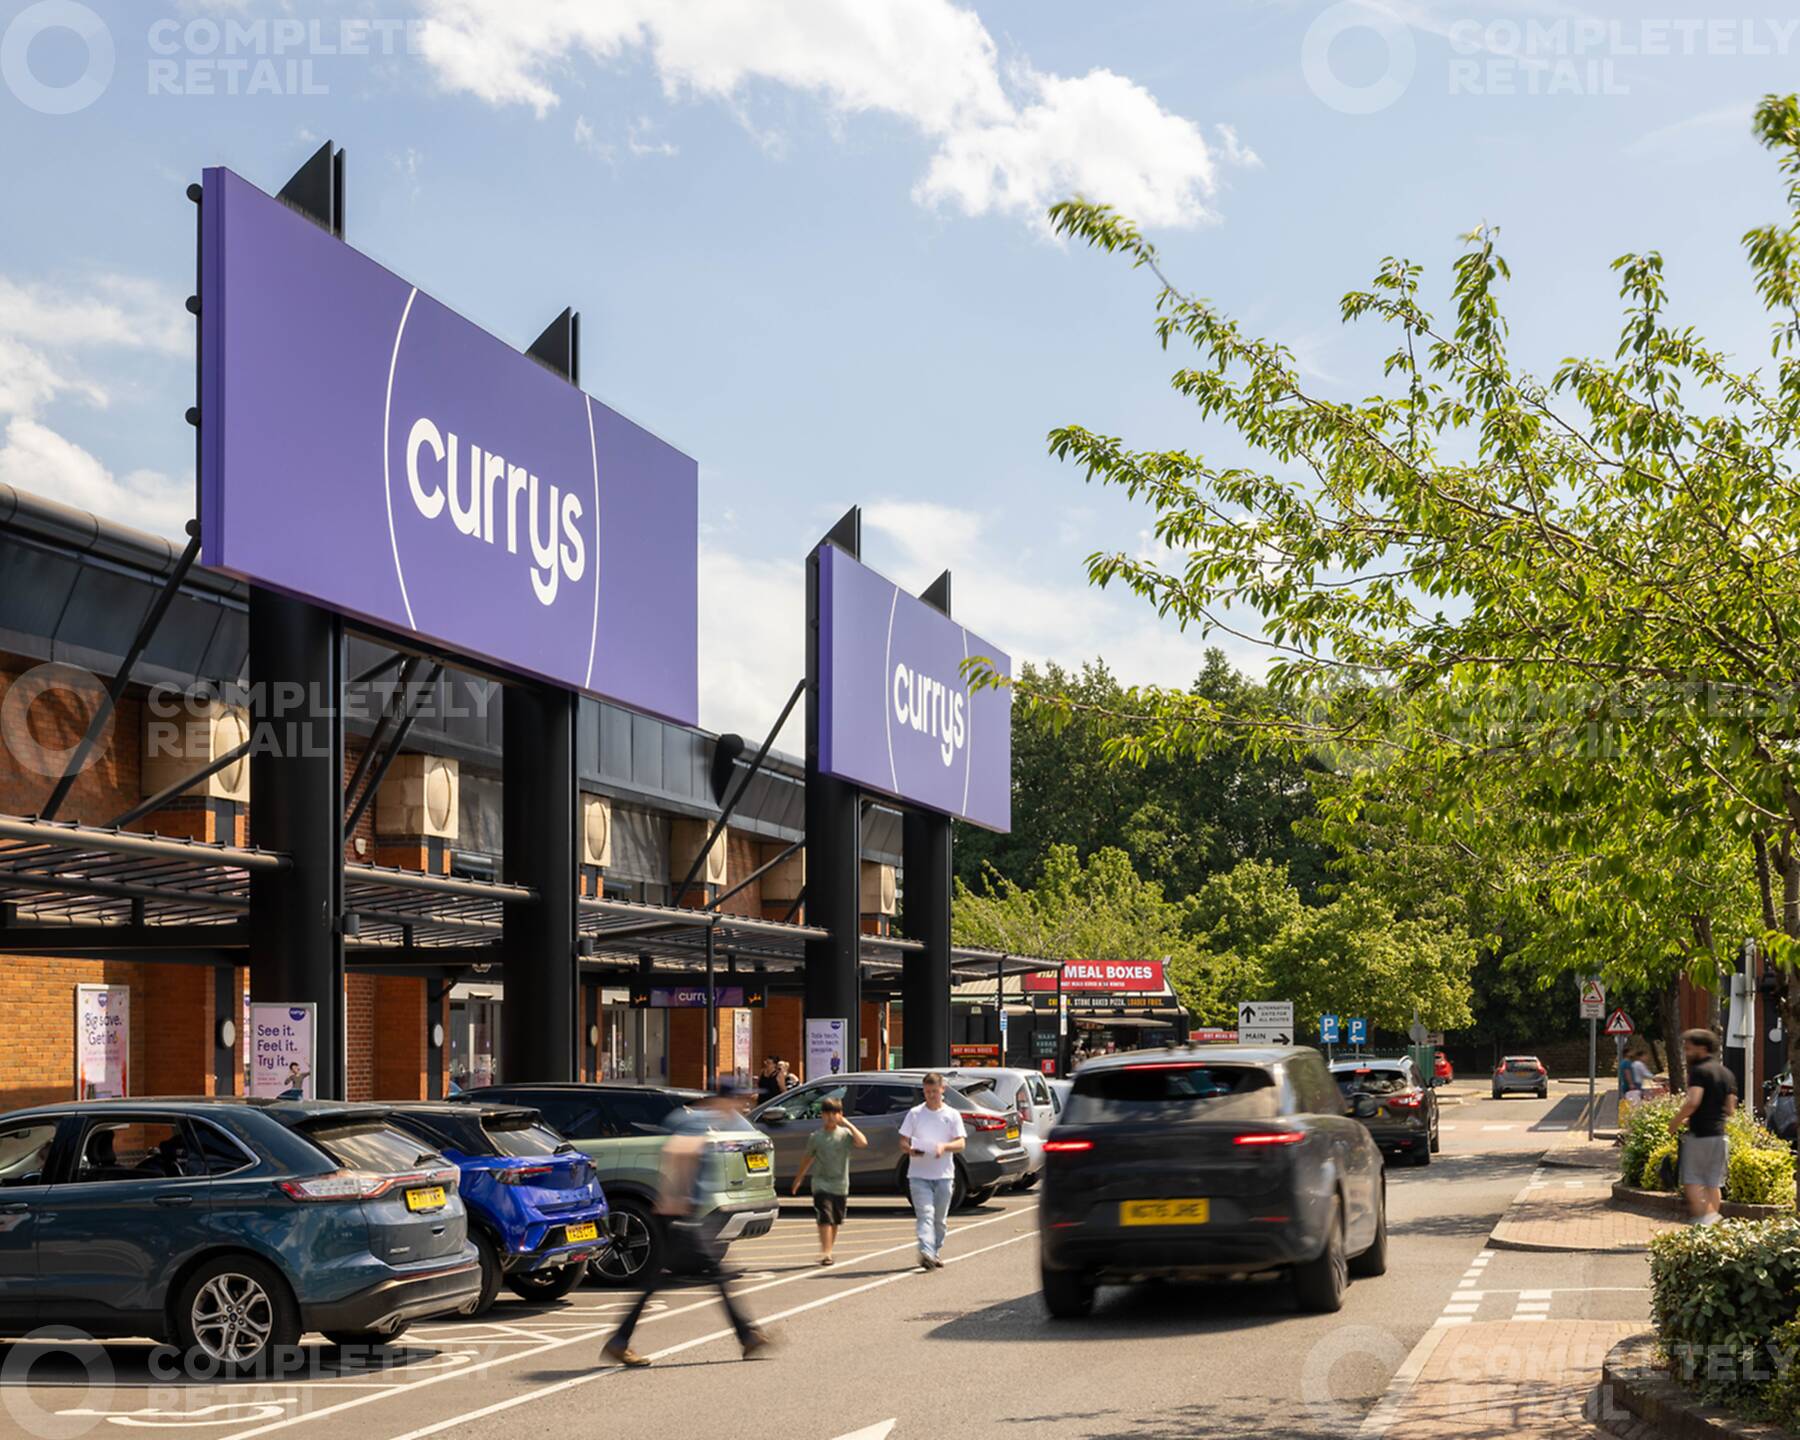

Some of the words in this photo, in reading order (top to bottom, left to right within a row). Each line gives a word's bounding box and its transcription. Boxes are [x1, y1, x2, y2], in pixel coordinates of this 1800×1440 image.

[406, 418, 586, 606] currys
[894, 663, 965, 767] currys
[1064, 965, 1104, 979] MEAL
[1106, 965, 1153, 979] BOXES
[678, 991, 715, 1004] curry
[98, 1014, 122, 1026] save.
[1324, 1018, 1335, 1032] P
[257, 1024, 280, 1037] See
[282, 1024, 295, 1037] it.
[1352, 1021, 1363, 1034] P
[257, 1039, 282, 1052] Feel
[285, 1039, 298, 1052] it.
[257, 1054, 274, 1070] Try
[277, 1054, 289, 1067] it.
